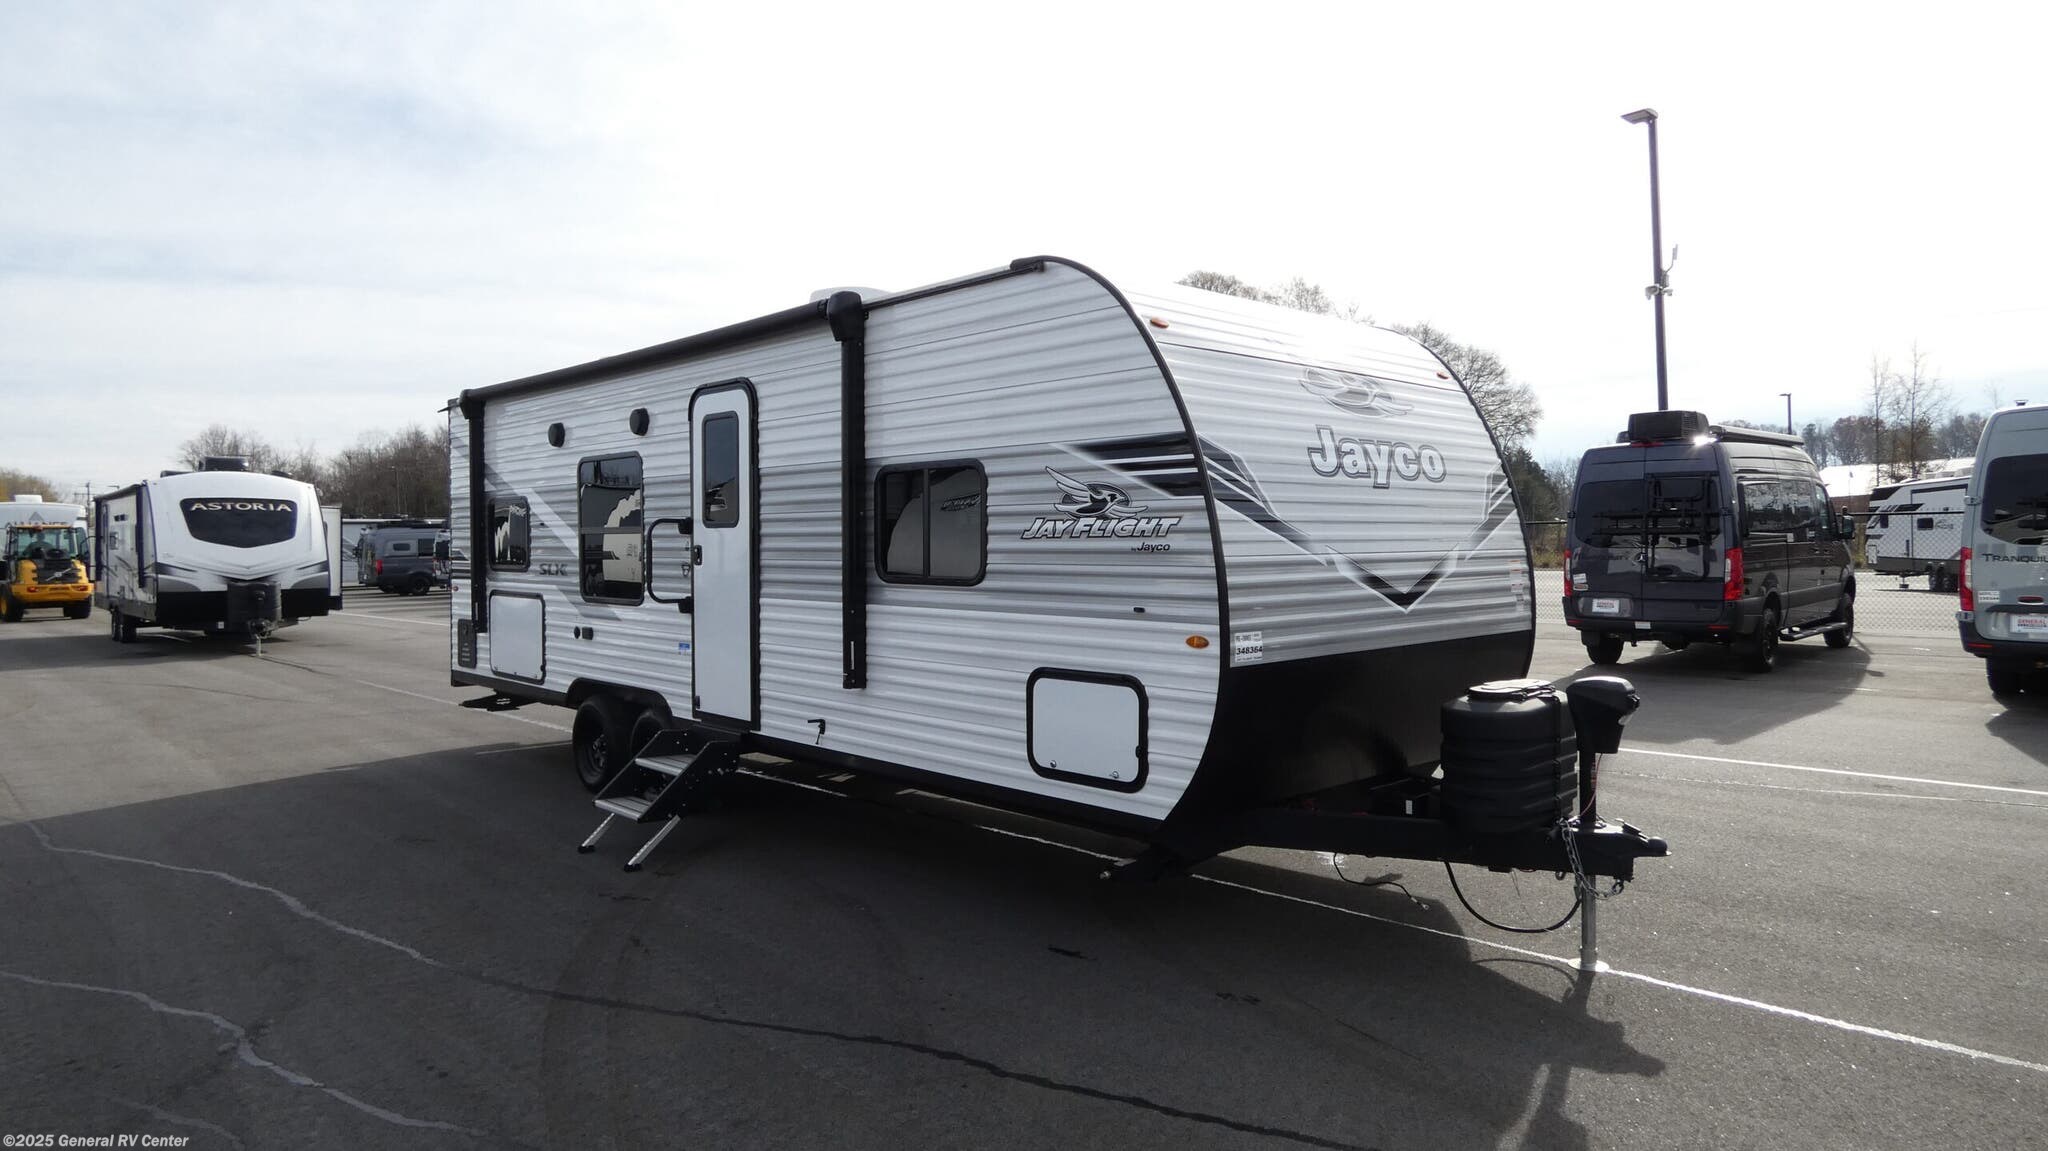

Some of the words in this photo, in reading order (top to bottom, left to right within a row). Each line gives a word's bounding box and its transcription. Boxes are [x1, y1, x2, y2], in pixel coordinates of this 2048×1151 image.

[1307, 424, 1447, 489] Jayco
[190, 502, 293, 512] ASTORIA
[1137, 542, 1171, 552] Jayco
[539, 563, 569, 576] SLK
